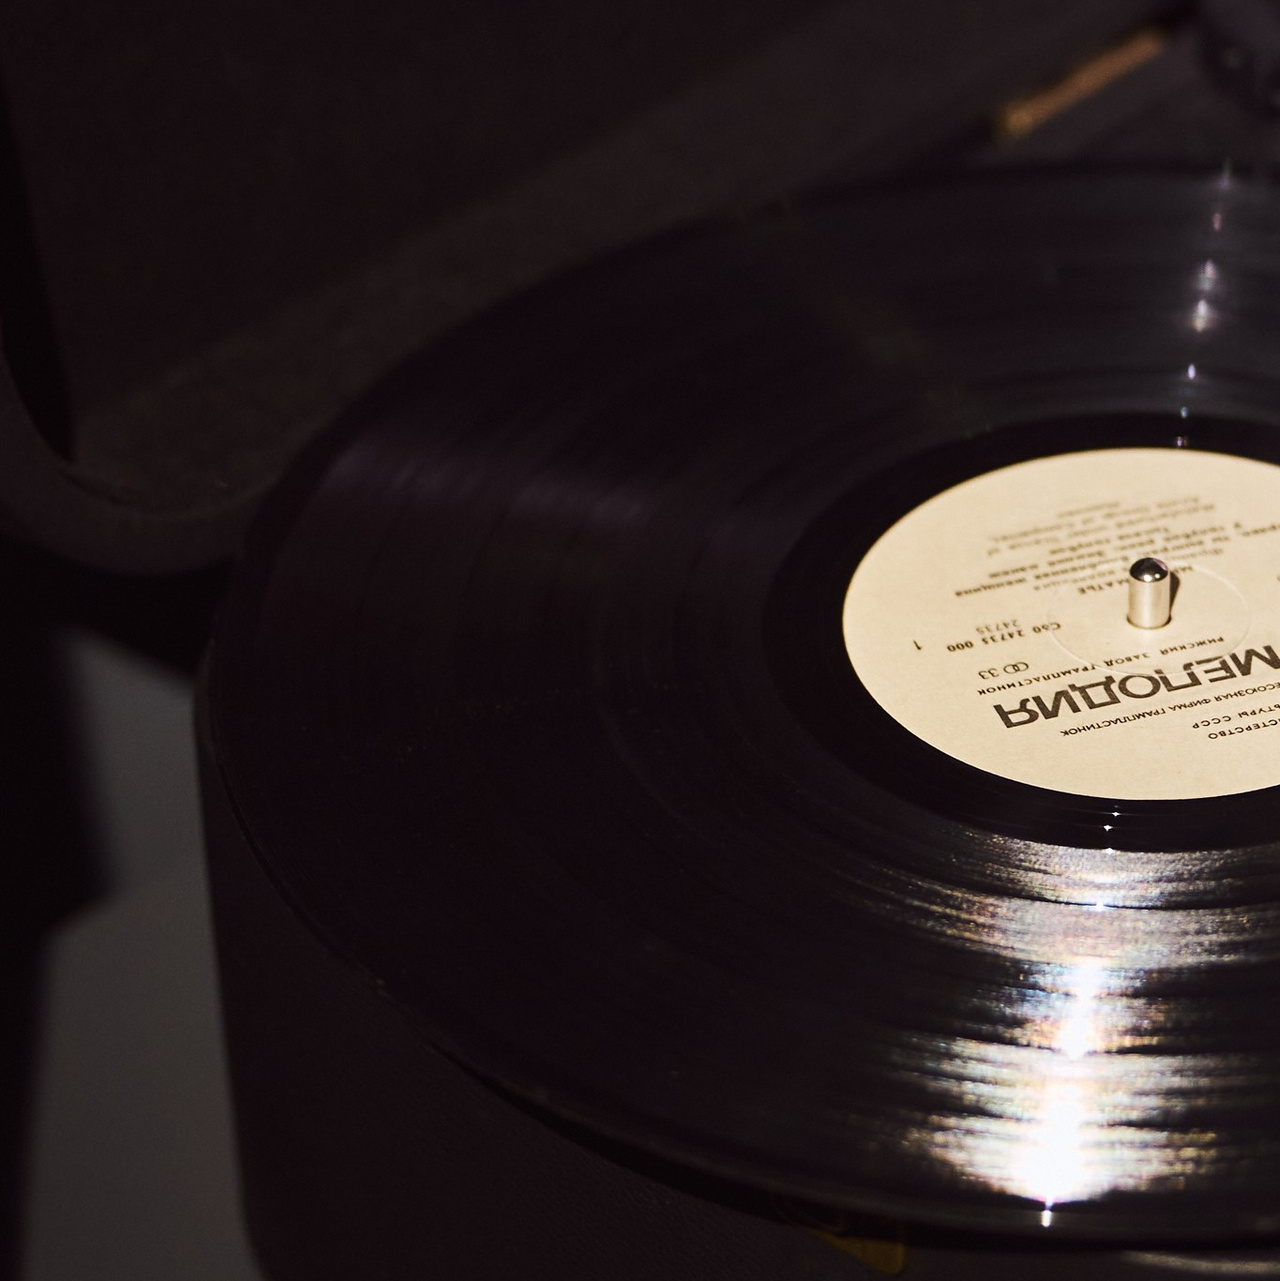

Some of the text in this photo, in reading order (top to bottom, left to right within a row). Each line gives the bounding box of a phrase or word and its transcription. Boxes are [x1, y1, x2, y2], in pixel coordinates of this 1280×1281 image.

[978, 635, 1224, 694] РИЖСКИЙ ЗАВОД ГРАМПЛАСТИНОК
[979, 667, 998, 679] 33
[1169, 697, 1211, 711] ФИРМА
[1060, 708, 1166, 736] ГРАМПЛАСТИНОК
[1192, 715, 1231, 728] СССР
